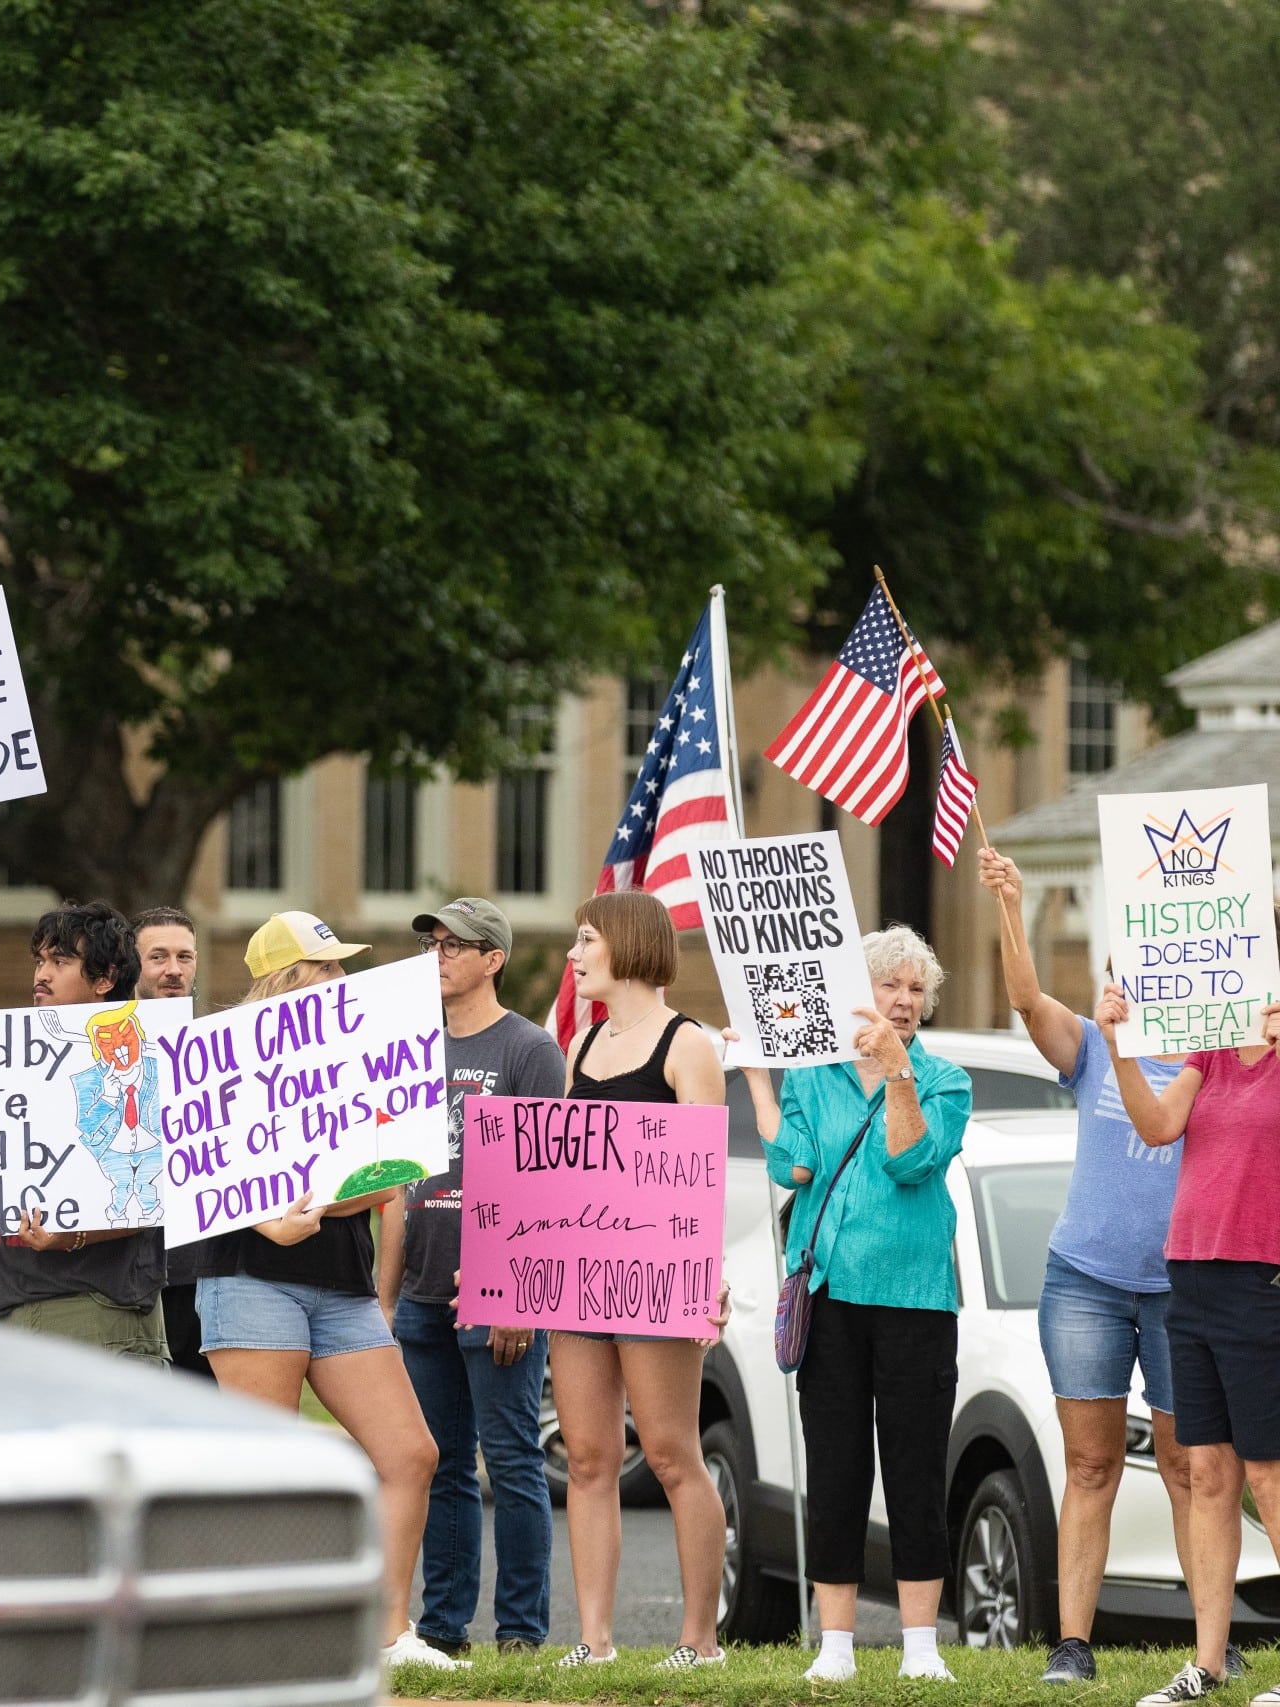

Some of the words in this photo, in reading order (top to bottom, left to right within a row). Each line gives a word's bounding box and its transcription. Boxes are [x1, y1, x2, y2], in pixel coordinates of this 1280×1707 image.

[699, 849, 727, 880] NO
[728, 842, 829, 878] THRONES
[1171, 847, 1203, 871] NO
[706, 882, 734, 913] NO
[737, 874, 836, 912] CROWNS
[1163, 872, 1215, 888] KINGS
[713, 914, 750, 955] NO
[752, 908, 843, 954] KINGS
[1125, 893, 1251, 938] HISTORY
[1139, 933, 1260, 967] DOESN'T
[1121, 974, 1193, 1004] NEED
[1201, 969, 1244, 997] TO
[24, 1015, 73, 1081] by
[157, 1025, 240, 1096] YOU
[1161, 1031, 1246, 1053] ITSELF
[161, 1075, 242, 1144] GOLF
[362, 1028, 440, 1082] WAY
[453, 1068, 485, 1082] KING
[301, 1092, 372, 1150] this
[513, 1101, 625, 1173] BIGGER
[24, 1121, 76, 1187] by
[634, 1150, 716, 1188] PARADE
[424, 1199, 462, 1209] NOTHING
[506, 1204, 656, 1241] smaller
